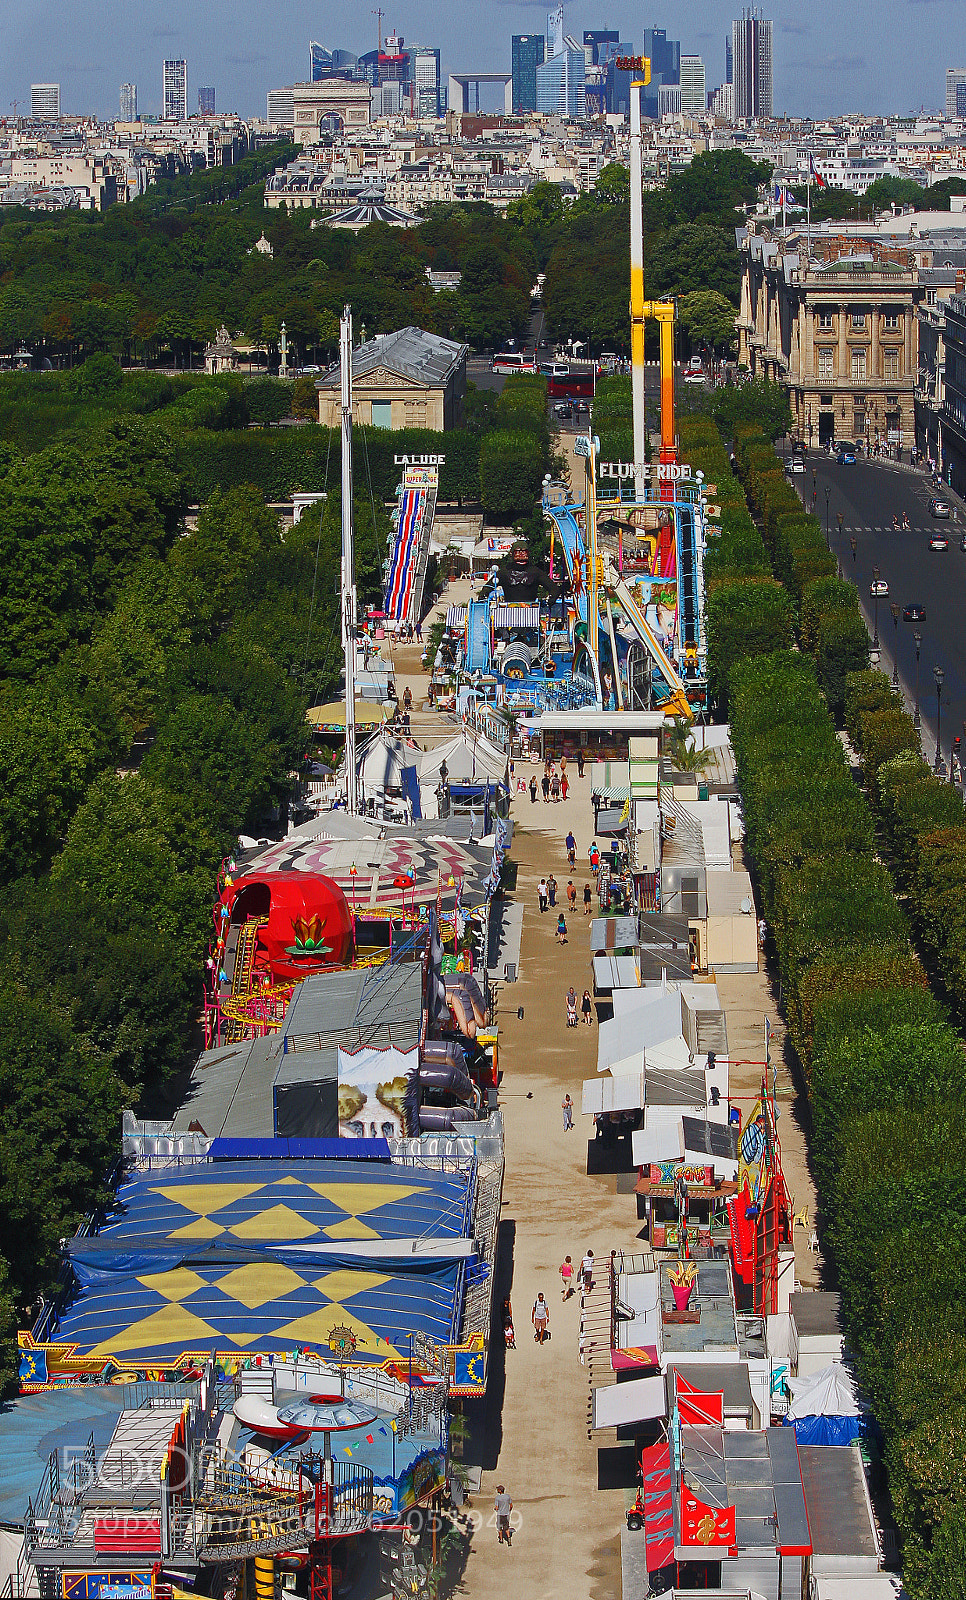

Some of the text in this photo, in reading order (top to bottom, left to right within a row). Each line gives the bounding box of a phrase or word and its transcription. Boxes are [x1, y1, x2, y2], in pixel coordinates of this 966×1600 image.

[394, 454, 446, 465] LA LUGE
[599, 462, 692, 481] FLUME RIDE
[656, 1162, 676, 1183] X
[644, 1468, 675, 1545] CASH
